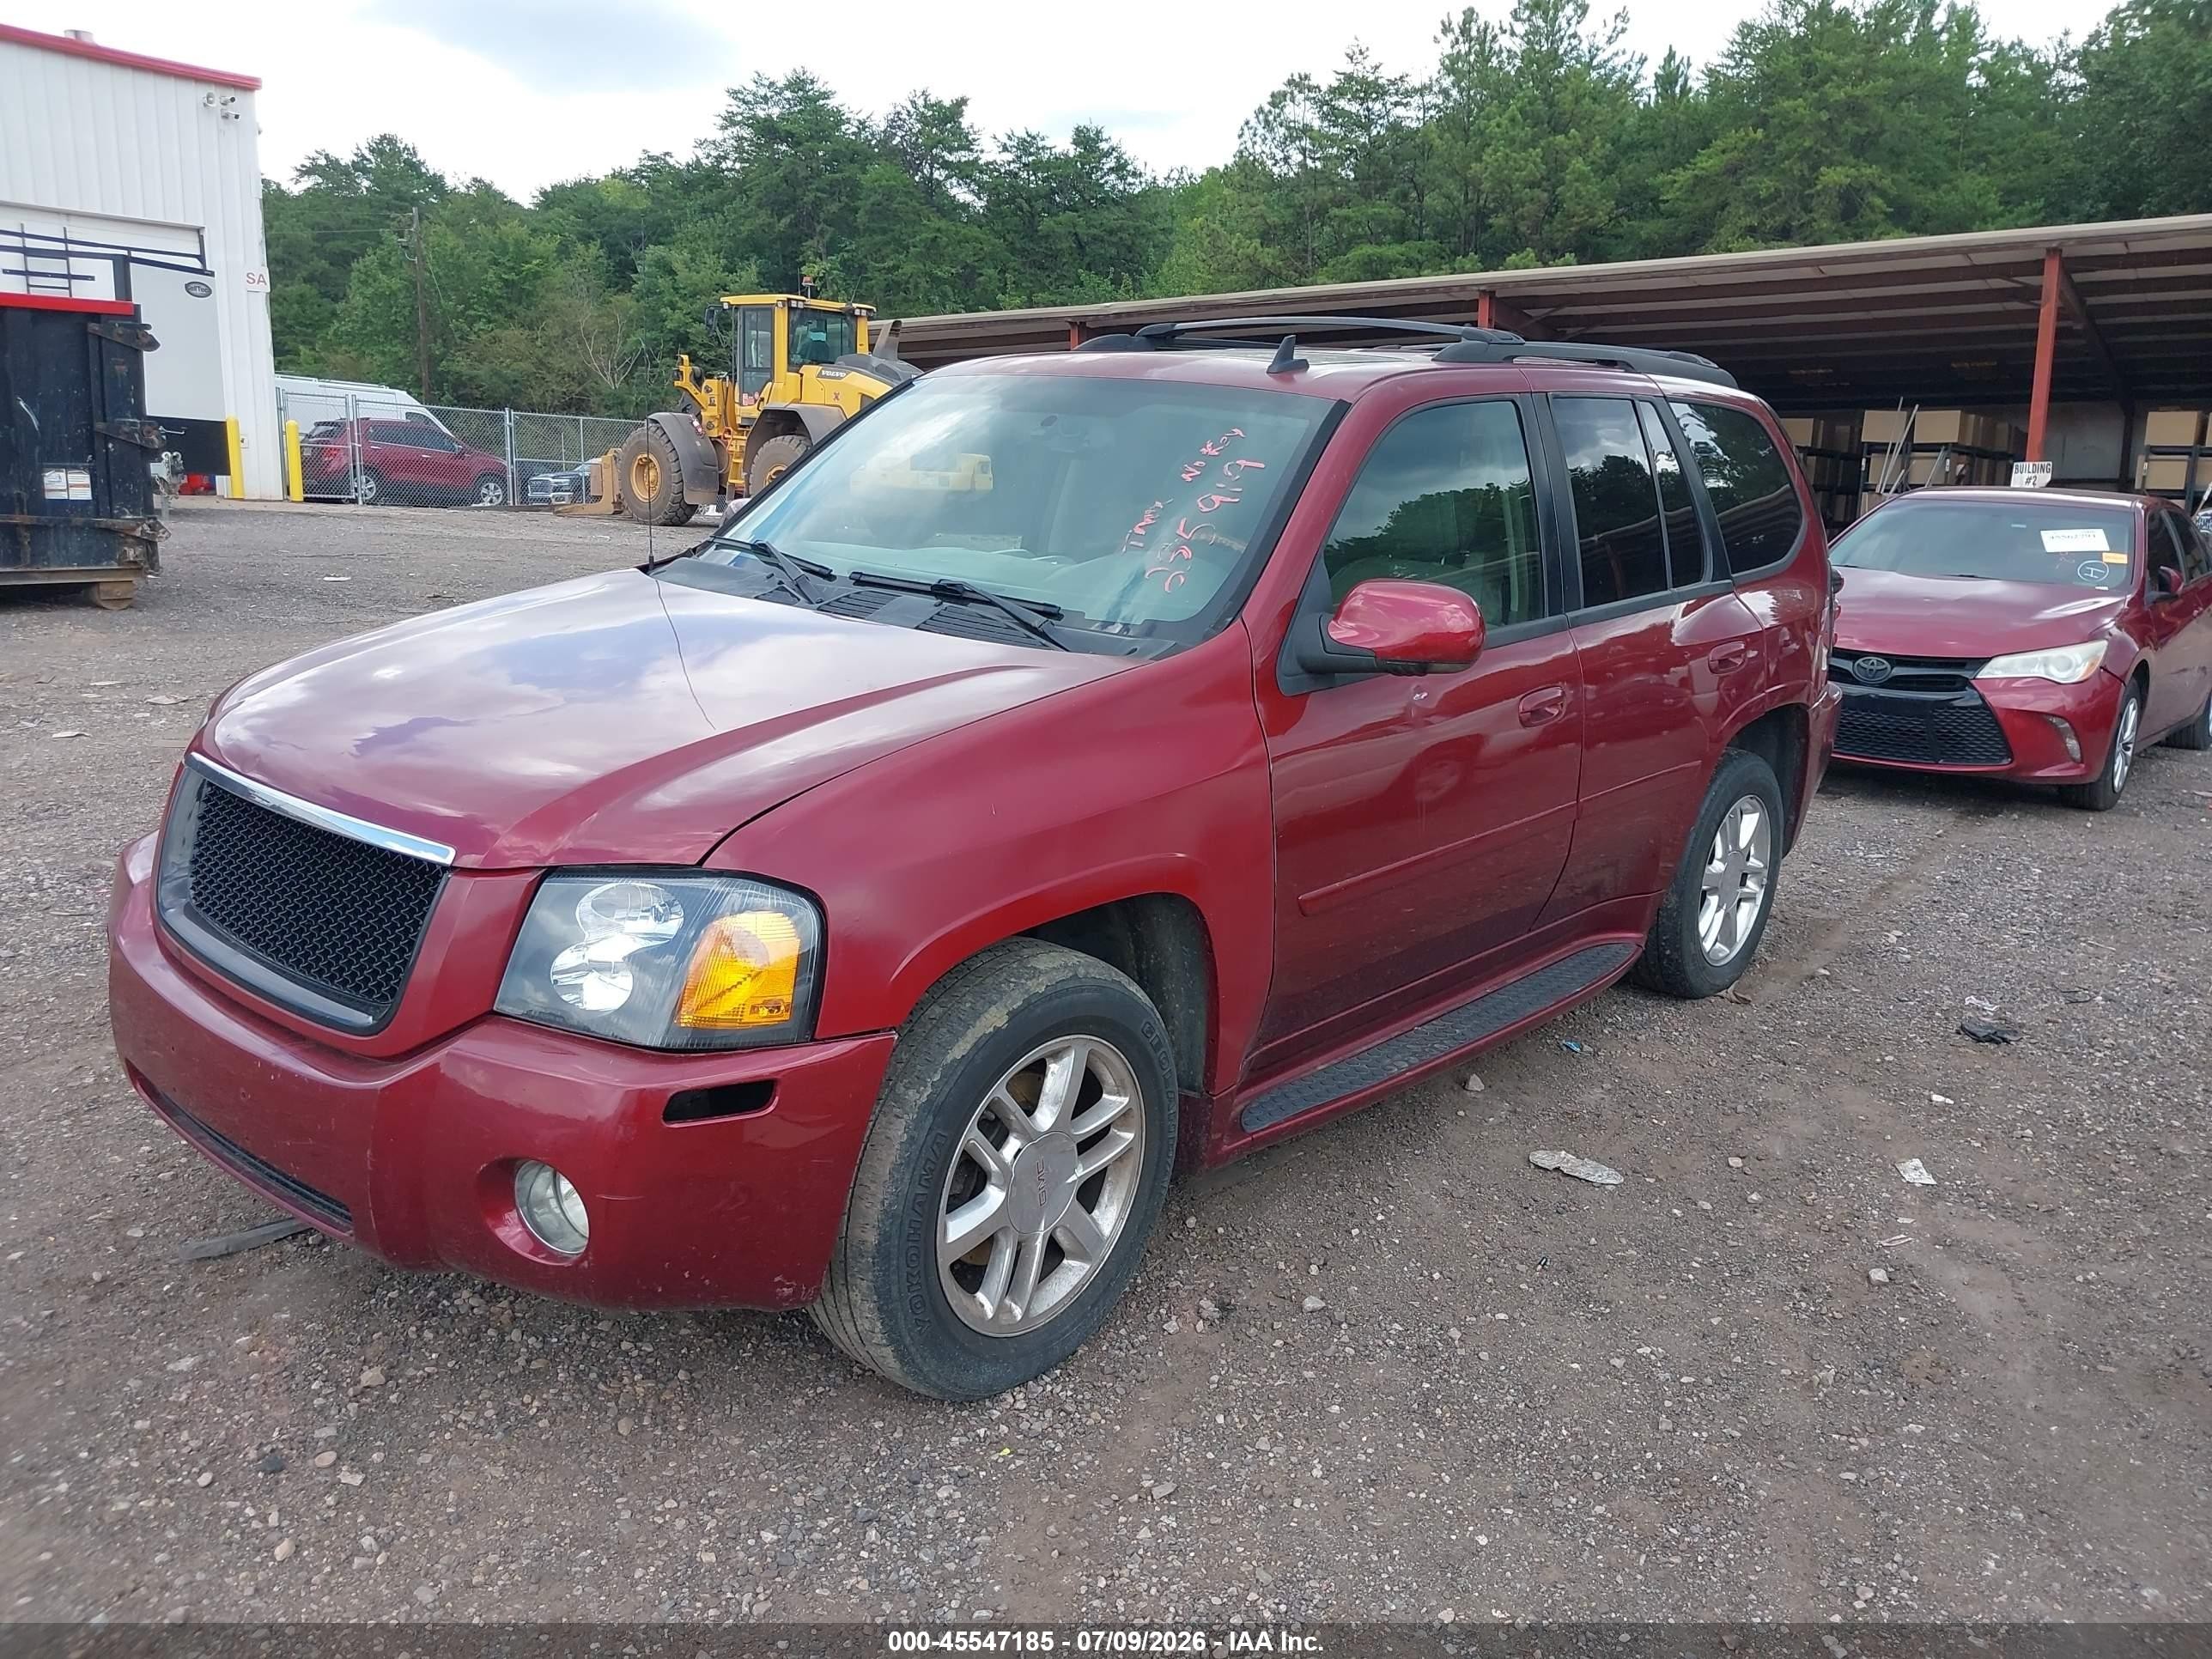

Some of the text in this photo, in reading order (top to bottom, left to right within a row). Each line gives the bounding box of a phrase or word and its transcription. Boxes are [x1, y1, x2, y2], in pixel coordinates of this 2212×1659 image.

[822, 369, 847, 378] VOLVO
[2014, 463, 2052, 475] BUILDING
[2025, 475, 2038, 486] #2
[1036, 1157, 1047, 1206] GMC
[905, 1132, 948, 1334] YOKOHAMA
